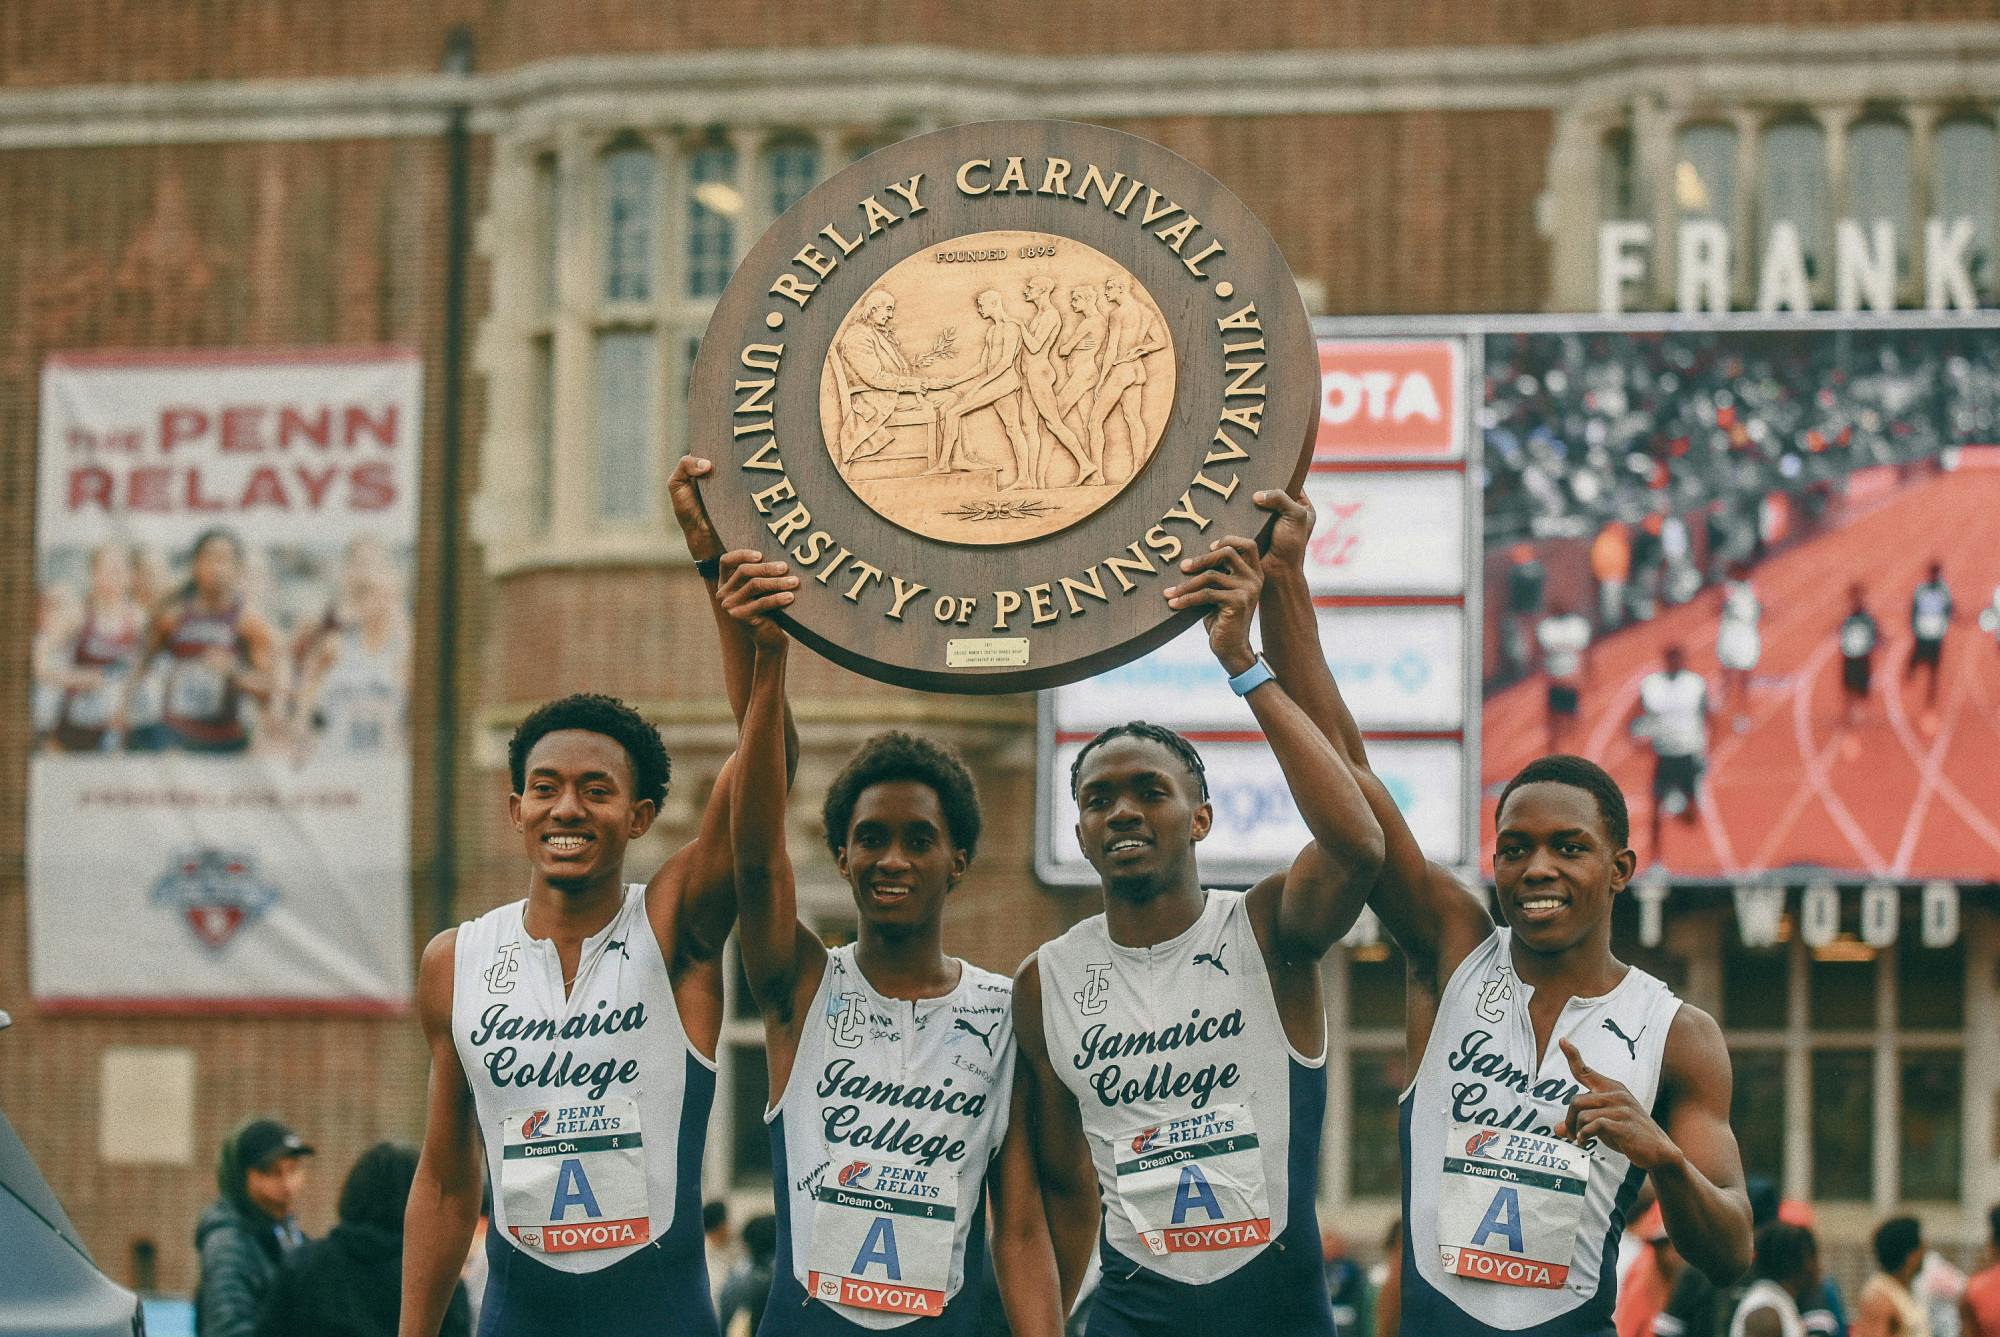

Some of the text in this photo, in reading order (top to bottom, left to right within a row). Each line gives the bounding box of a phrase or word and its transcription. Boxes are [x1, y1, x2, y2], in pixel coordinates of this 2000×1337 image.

[769, 157, 1226, 310] RELAY CARNIVAL
[936, 245, 1056, 263] FOUNDED 1895
[1600, 220, 1980, 318] FRANK
[1321, 371, 1441, 425] OTA
[64, 405, 398, 453] THE PENN
[733, 301, 1266, 631] UNIVERSITY OF PENNSYLVANIA
[64, 462, 398, 513] RELAYS
[471, 1000, 648, 1046] Jamaica
[1073, 1008, 1246, 1070] Jamaica
[484, 1046, 639, 1100] College
[1089, 1063, 1240, 1109] College
[817, 1059, 986, 1118] Jamaica
[555, 1117, 621, 1134] RELAYS
[557, 1105, 605, 1121] PENN
[1169, 1111, 1217, 1132] PENN
[822, 1105, 965, 1166] College
[1169, 1120, 1235, 1144] RELAYS
[1506, 1135, 1559, 1154] PENN
[525, 1141, 578, 1157] Dream On.
[1139, 1151, 1194, 1171] Dream On.
[1502, 1148, 1571, 1171] RELAYS
[879, 1166, 928, 1183] PENN
[1463, 1162, 1519, 1181] Dream On.
[549, 1159, 603, 1221] A
[837, 1193, 893, 1211] Dream On.
[875, 1179, 940, 1198] RELAYS
[1171, 1164, 1224, 1225] A
[1471, 1186, 1524, 1253] A
[547, 1223, 636, 1247] TOYOTA
[851, 1217, 901, 1280] A
[1169, 1223, 1260, 1249] TOYOTA
[1465, 1253, 1551, 1283] TOYOTA
[845, 1283, 928, 1310] TOYOTA
